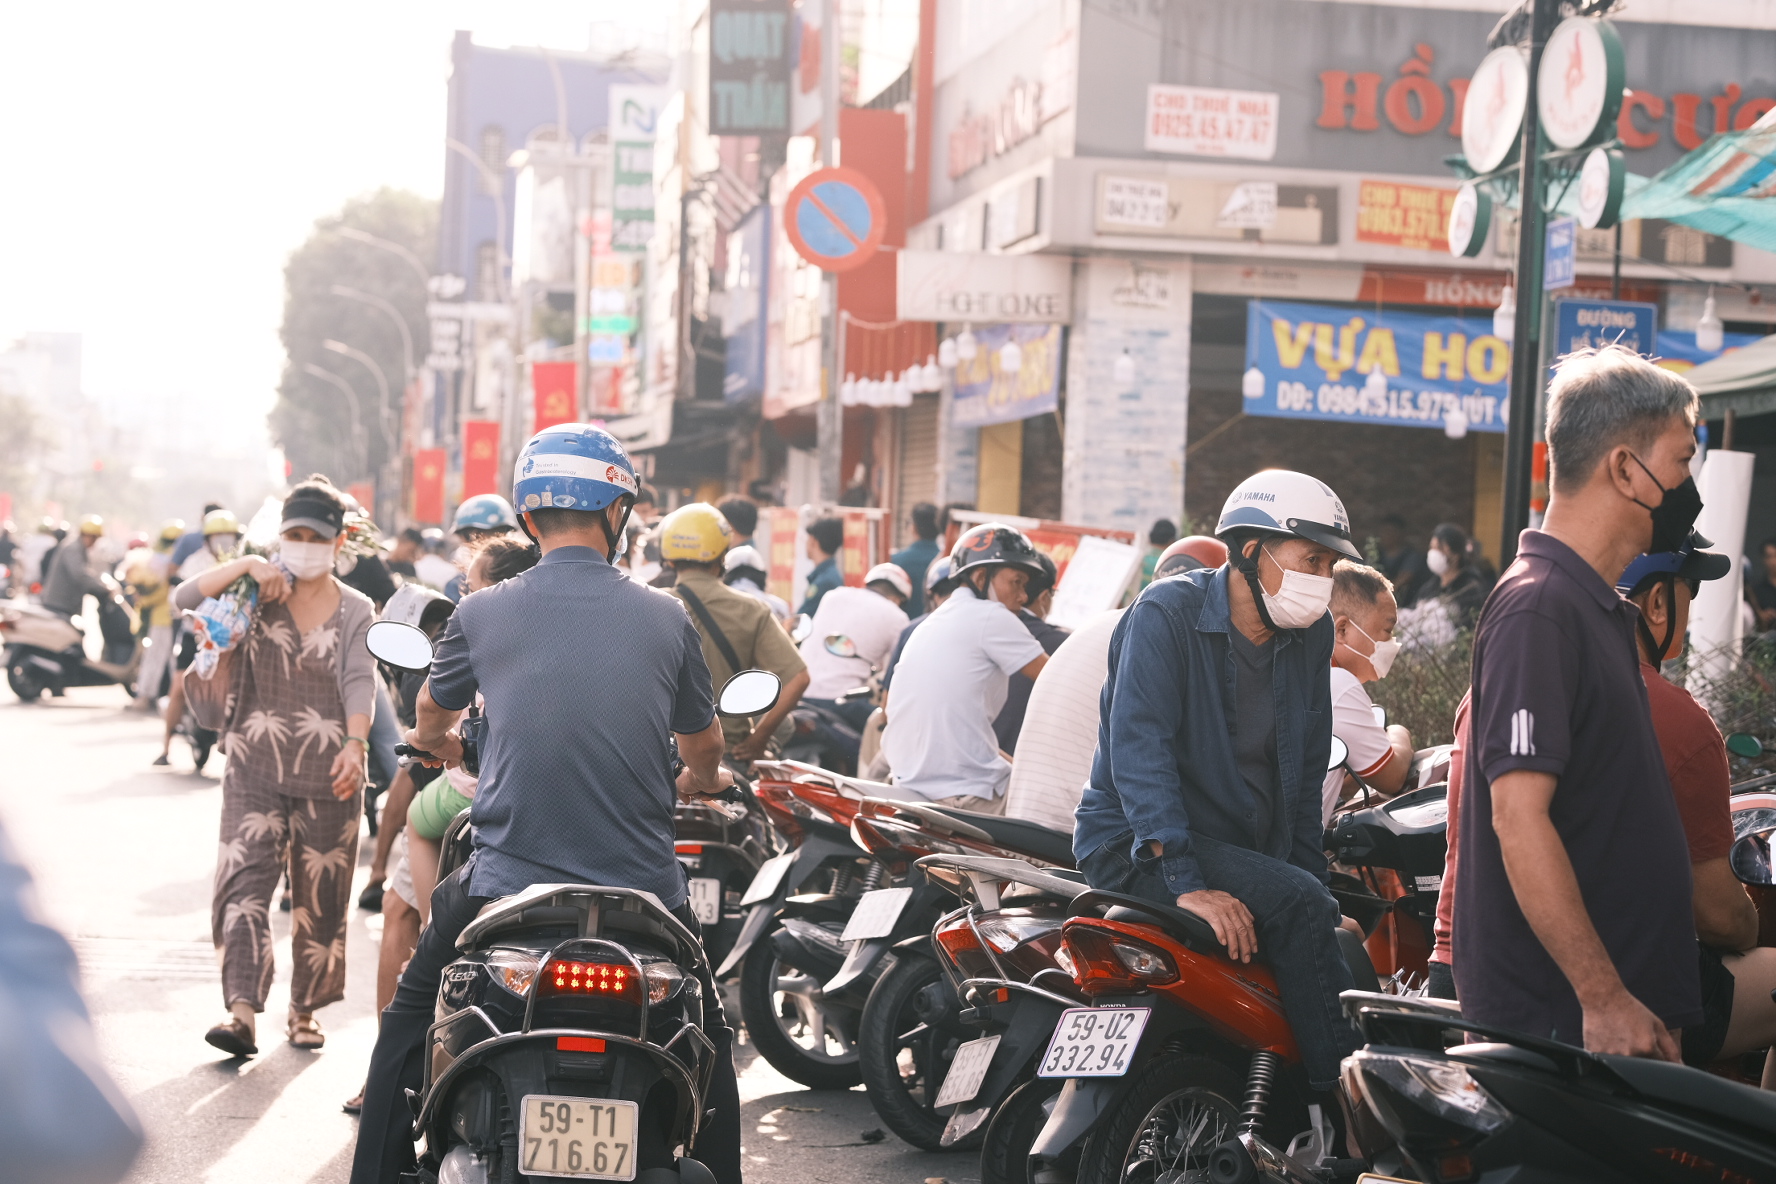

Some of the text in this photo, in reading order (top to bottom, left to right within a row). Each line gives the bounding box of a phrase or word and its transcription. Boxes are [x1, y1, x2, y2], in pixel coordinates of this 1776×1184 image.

[1272, 317, 1511, 385] VỰA HO
[1243, 492, 1276, 503] YAMAHA
[1068, 1013, 1135, 1041] 59-U2
[1046, 1043, 1128, 1072] 332.94
[540, 1102, 616, 1138] 59-T1
[526, 1137, 629, 1174] 716.67
